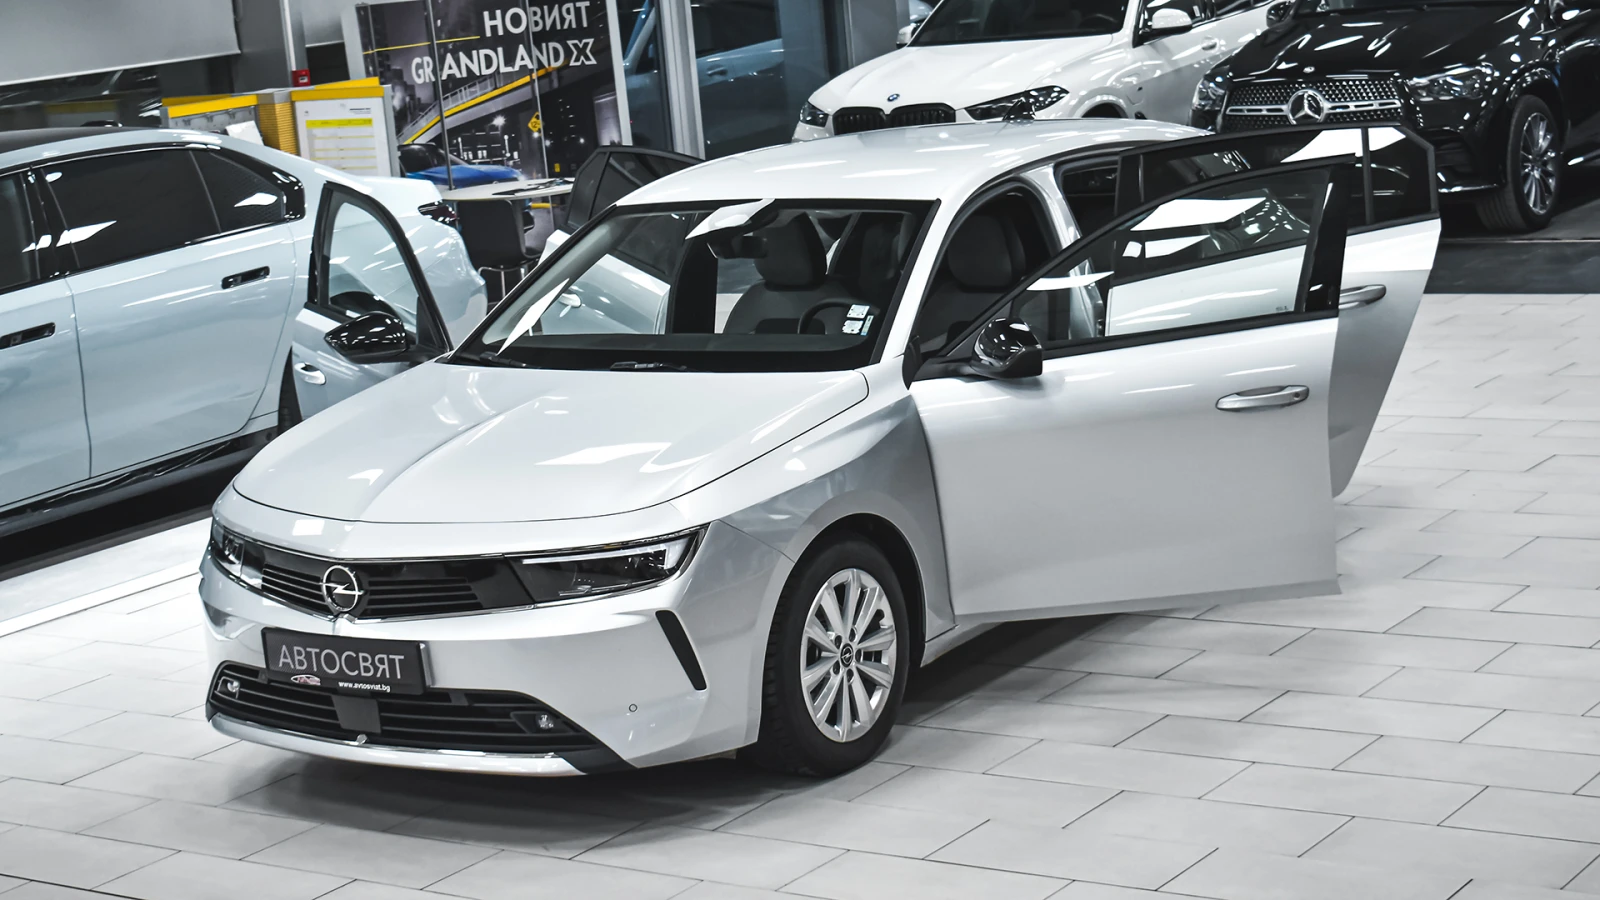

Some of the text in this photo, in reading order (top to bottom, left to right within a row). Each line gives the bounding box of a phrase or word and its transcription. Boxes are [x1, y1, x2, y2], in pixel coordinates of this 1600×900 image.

[483, 1, 590, 37] НОВИЯТ
[411, 42, 564, 84] GRANDLAND
[278, 644, 404, 679] АВТОСВЯТ
